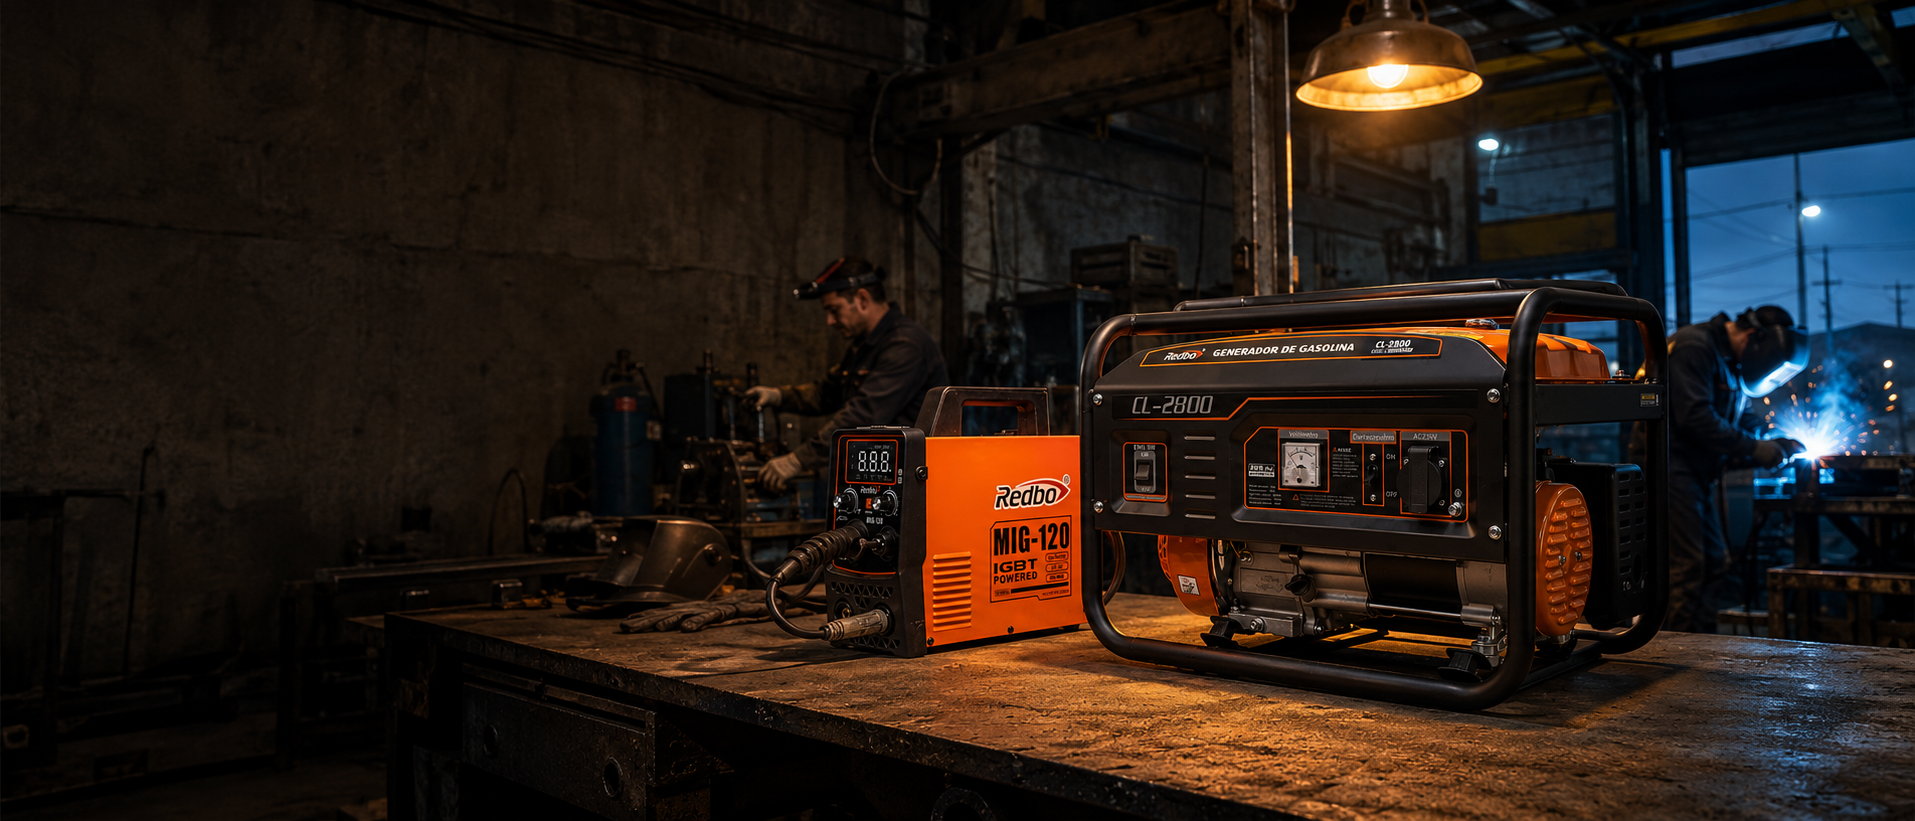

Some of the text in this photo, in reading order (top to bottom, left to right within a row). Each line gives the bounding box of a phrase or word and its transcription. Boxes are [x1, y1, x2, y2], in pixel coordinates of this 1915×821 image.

[1213, 342, 1355, 357] GENERADOR DE GASOLINA
[1375, 340, 1411, 349] CL-2800
[1132, 395, 1213, 414] CL-2800
[994, 485, 1058, 509] Redbo
[994, 522, 1070, 556] MIG-120
[994, 558, 1038, 574] IGBT
[994, 571, 1038, 585] POWERED
